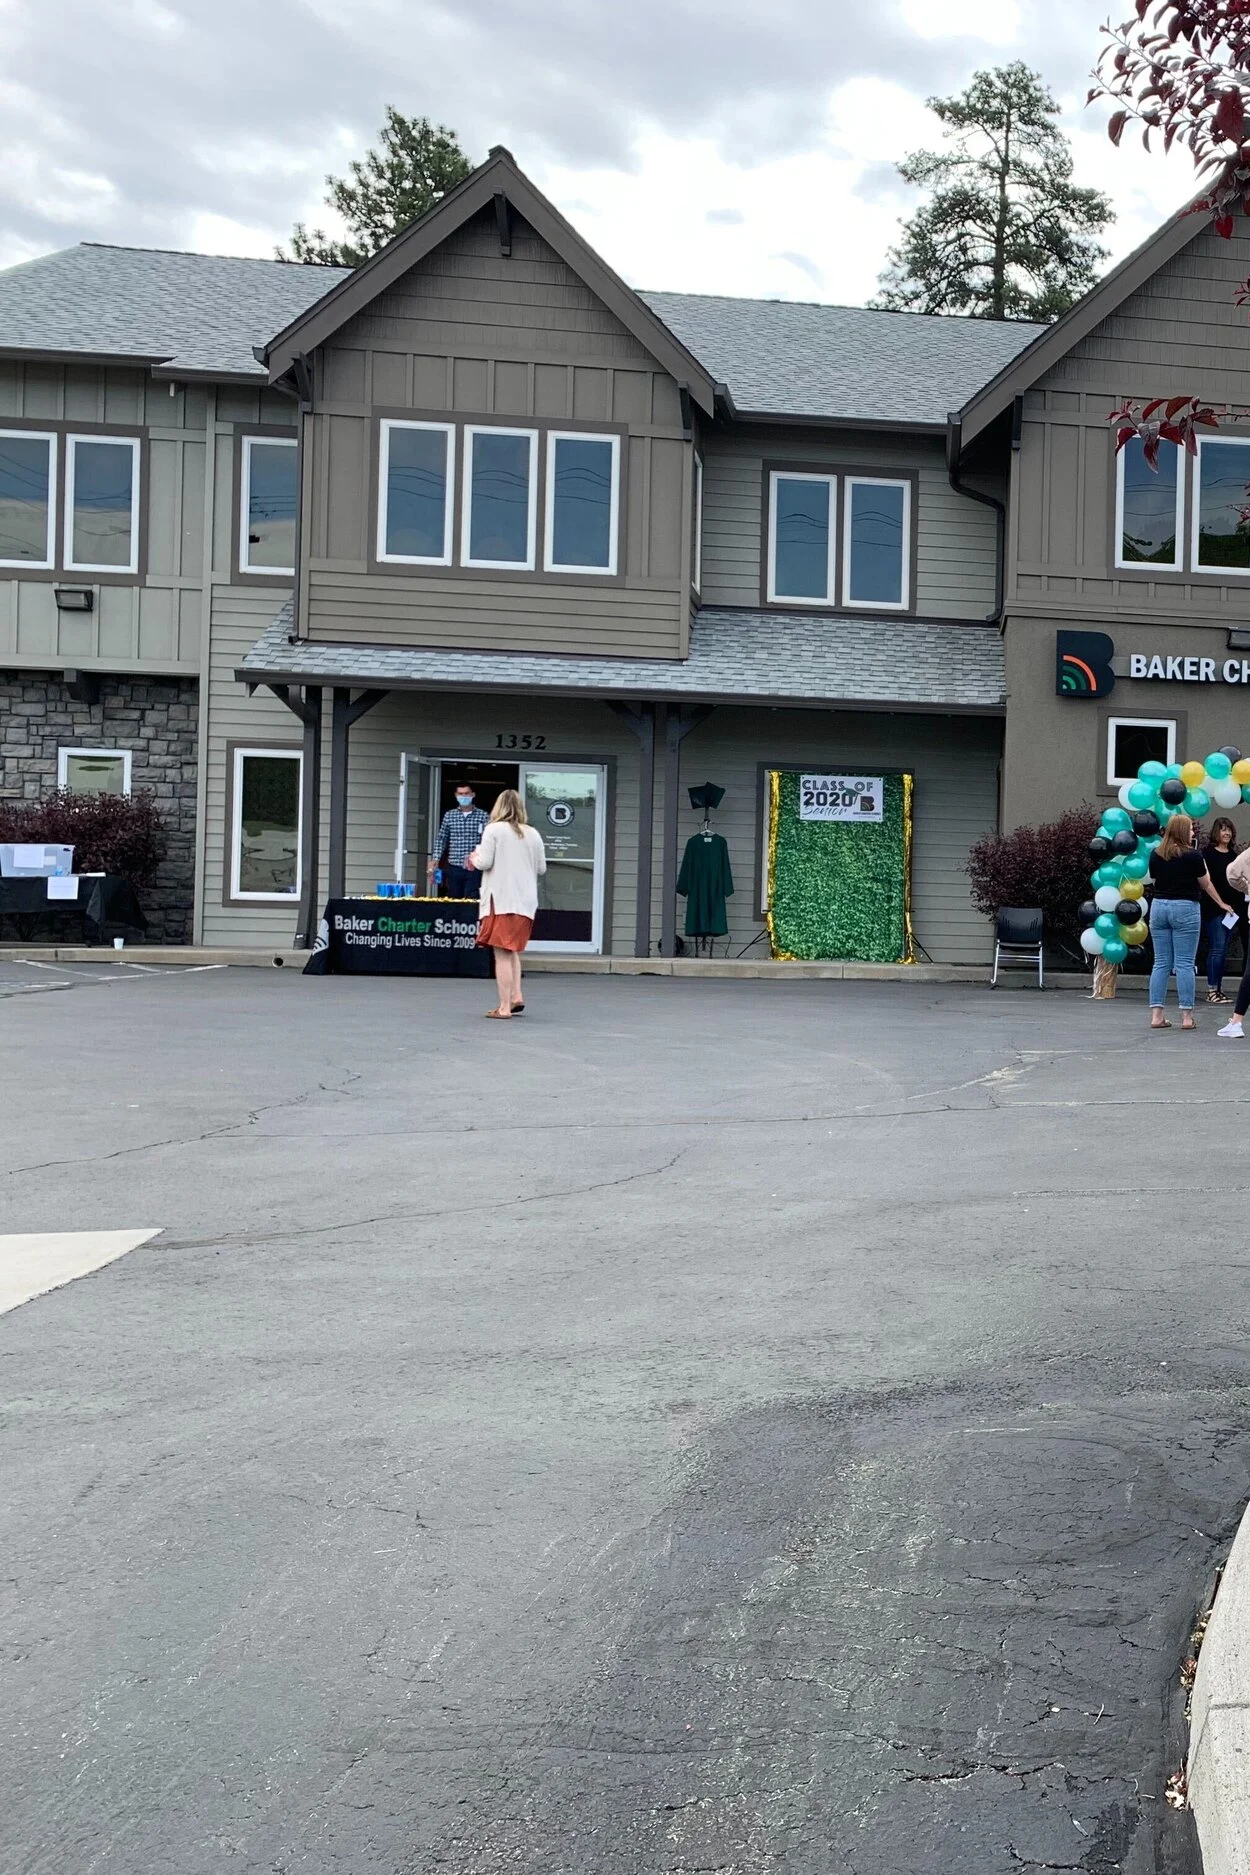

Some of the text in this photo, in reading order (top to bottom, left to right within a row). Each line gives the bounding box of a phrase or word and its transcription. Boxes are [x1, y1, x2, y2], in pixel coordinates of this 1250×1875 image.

[1130, 653, 1216, 682] BAKER
[495, 733, 547, 750] 1352
[802, 780, 873, 792] CLASS OF
[803, 791, 853, 807] 2020
[334, 915, 480, 936] Baker Charter School
[345, 932, 476, 949] Changing Lives Since 2009
